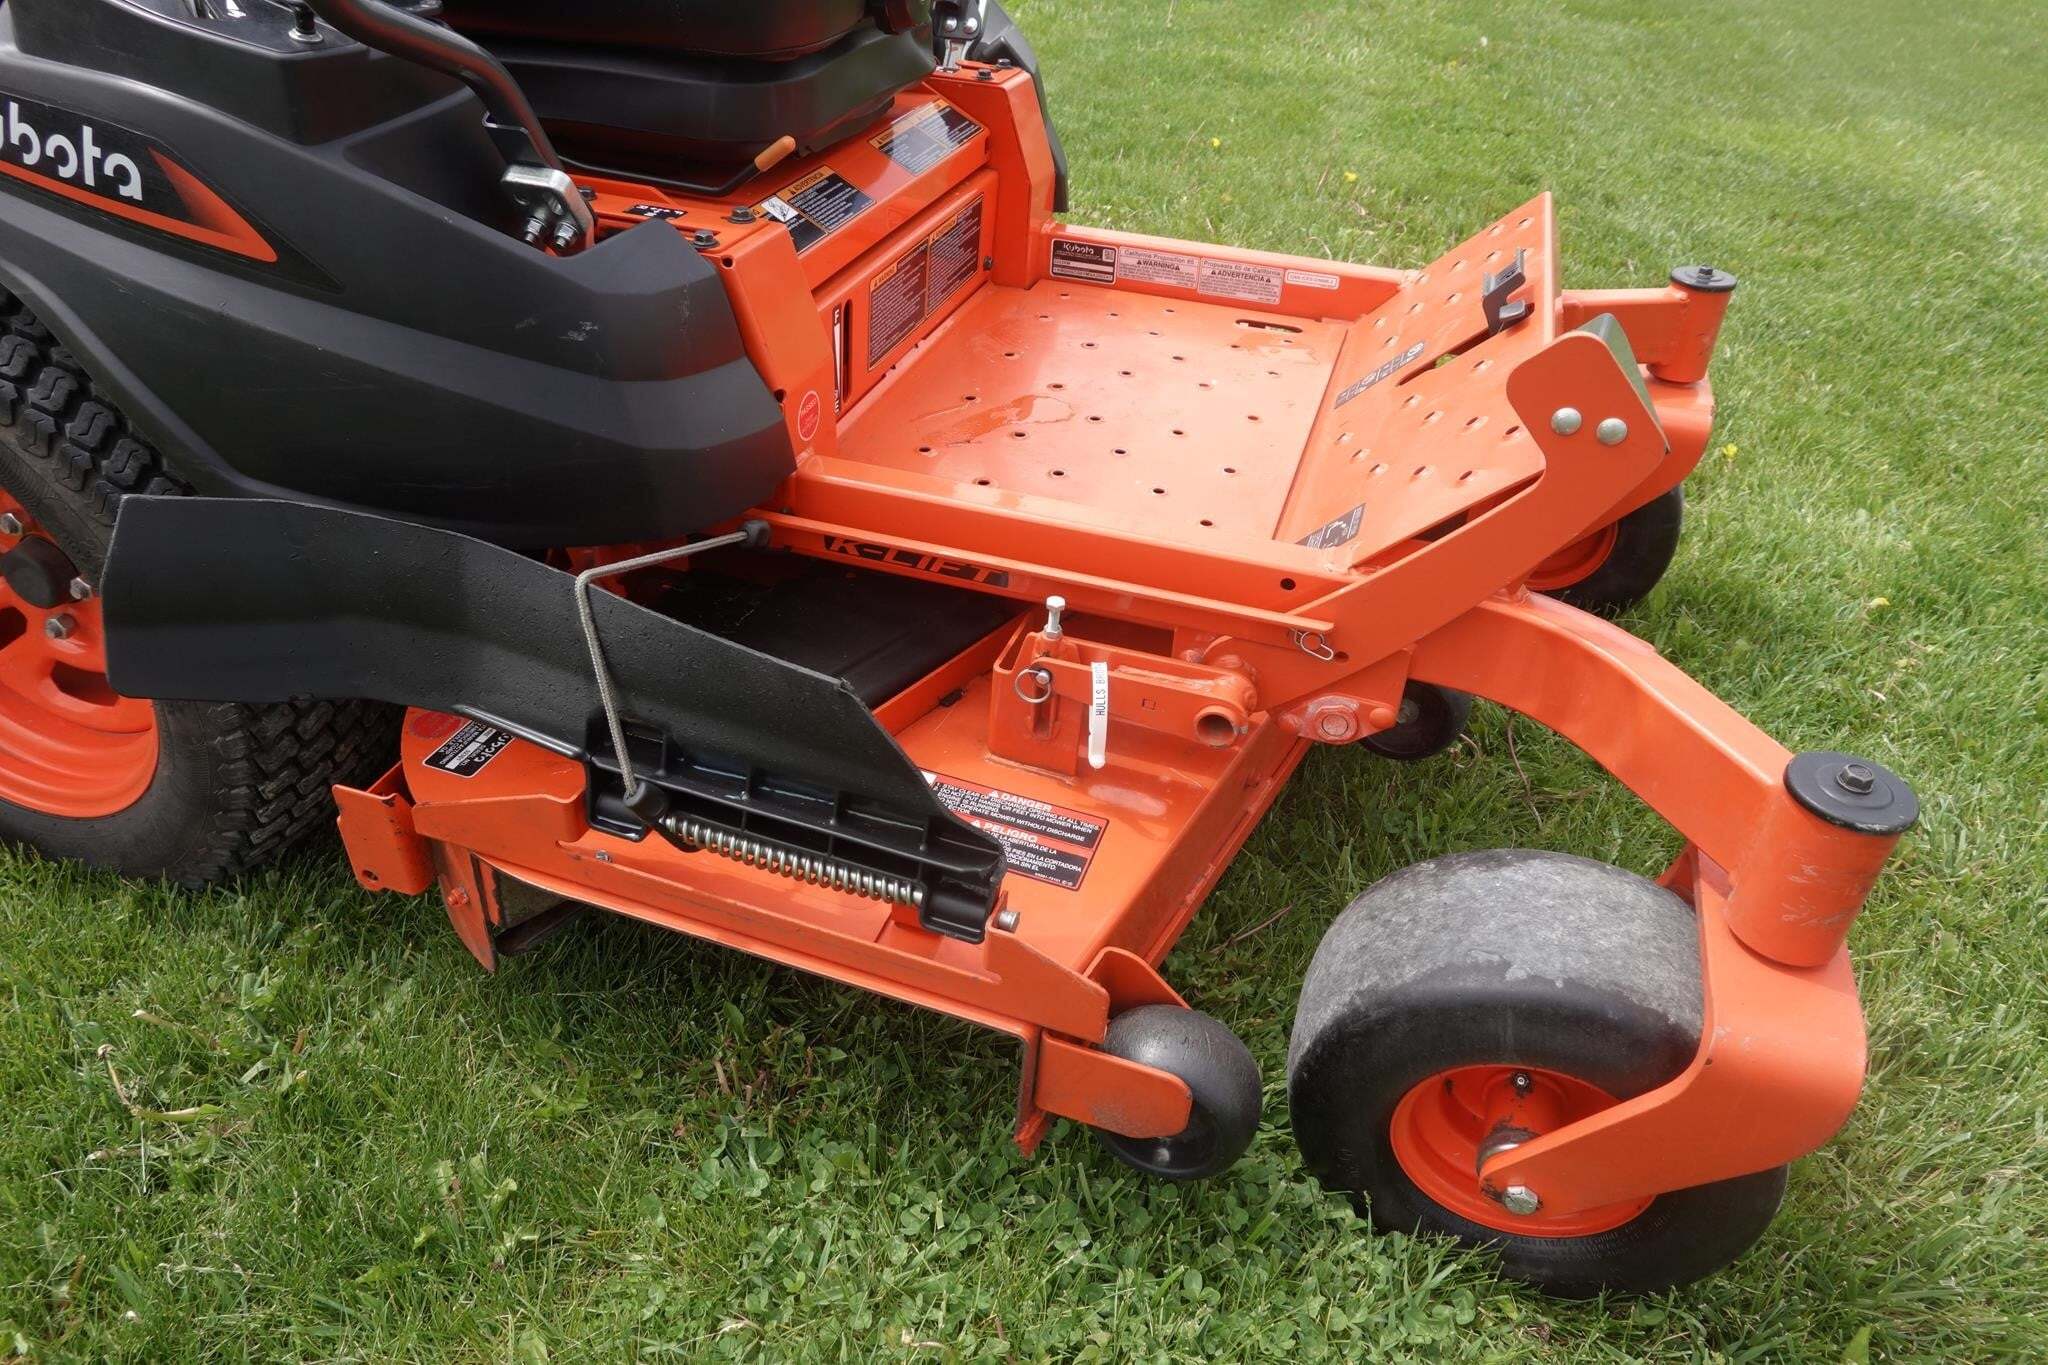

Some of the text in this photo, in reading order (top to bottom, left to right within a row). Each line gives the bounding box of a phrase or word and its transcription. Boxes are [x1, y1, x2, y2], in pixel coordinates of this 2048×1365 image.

[0, 101, 143, 201] bota
[1063, 242, 1094, 255] Kubota
[1143, 259, 1175, 270] WARNING
[1217, 270, 1265, 282] ADVERTENCIA
[828, 535, 1006, 584] K-LIFT
[1095, 688, 1106, 716] HULLS
[474, 732, 511, 763] ubota
[937, 792, 961, 801] ENGINE
[958, 788, 980, 797] CLEAR
[990, 797, 1026, 810] DISCHARGE
[1028, 807, 1057, 818] OPENING
[1001, 793, 1052, 811] DANGER
[960, 803, 989, 814] OPERATE
[990, 812, 1014, 821] MOWER
[1016, 819, 1046, 830] WITHOUT
[1046, 827, 1084, 841] DISCHARGE
[979, 798, 1000, 807] HANDS
[1029, 812, 1045, 820] INTO
[1045, 817, 1071, 827] MOWER
[1072, 824, 1092, 833] WHEN
[983, 822, 1038, 843] PELIGRO
[1007, 837, 1038, 849] ABERTURA
[1044, 857, 1081, 872] CORTADORA
